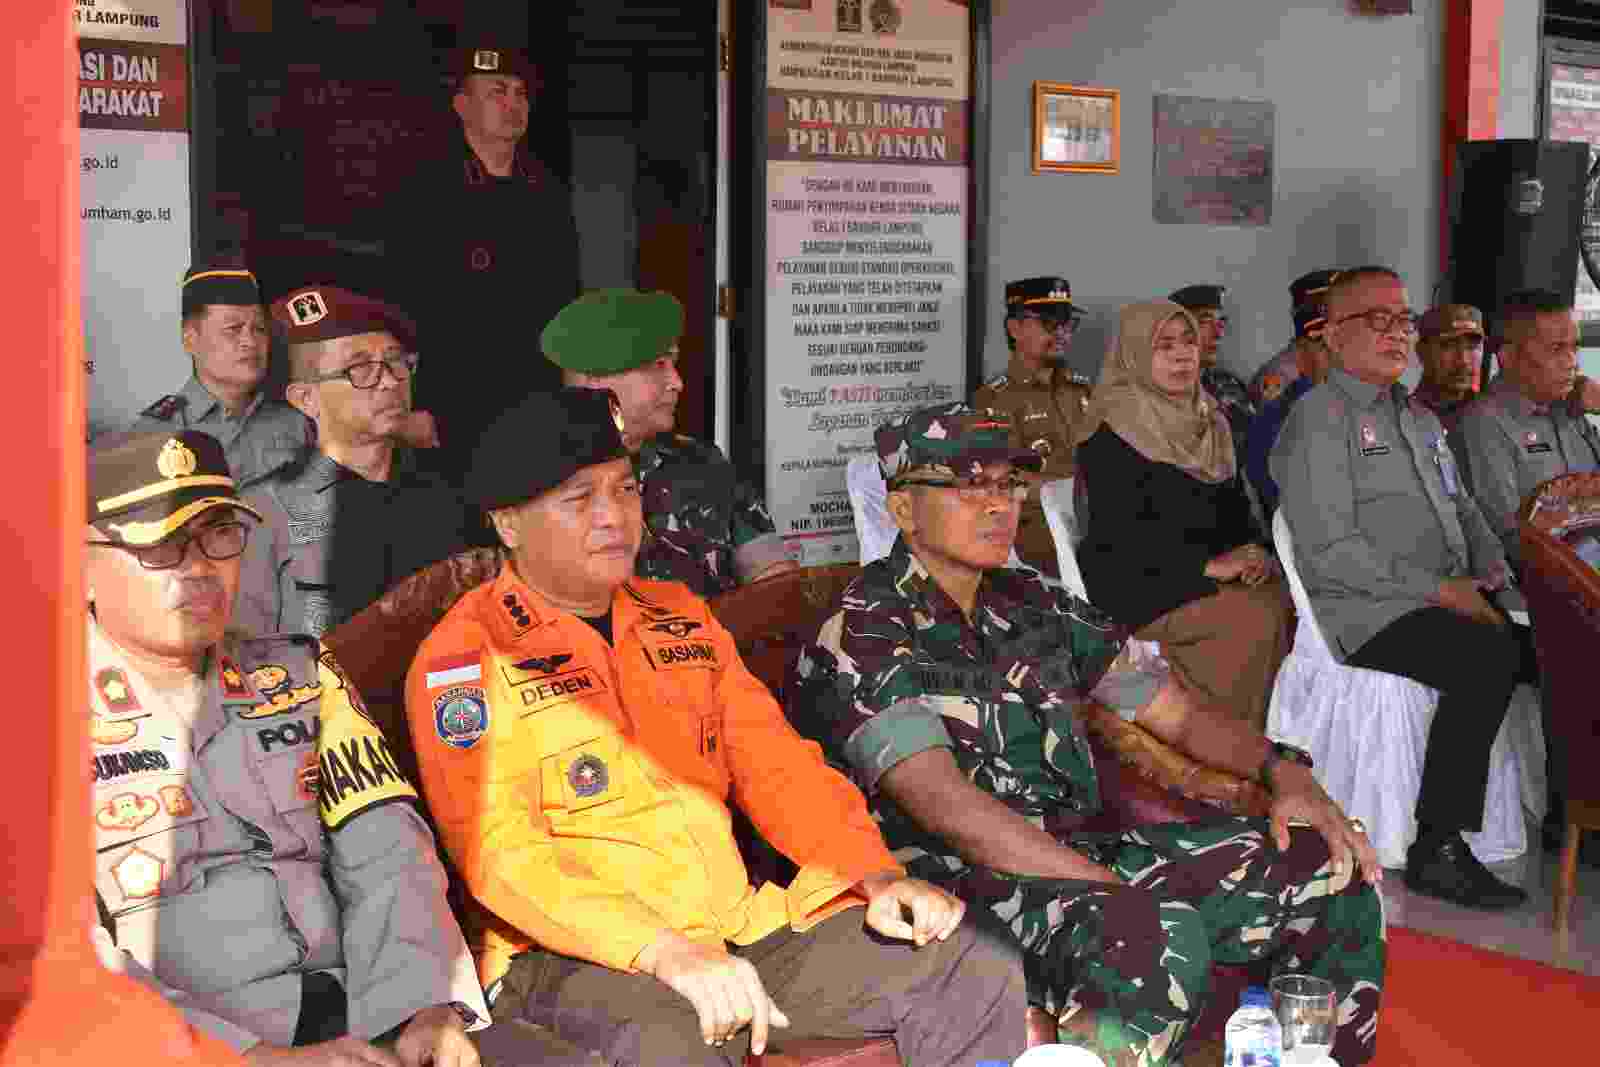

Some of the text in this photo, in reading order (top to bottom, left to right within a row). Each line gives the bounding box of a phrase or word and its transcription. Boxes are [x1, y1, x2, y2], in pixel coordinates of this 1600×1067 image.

[86, 11, 159, 28] LAMPUNG
[112, 54, 158, 82] DAN
[787, 97, 944, 129] MAKLUMAT
[788, 128, 946, 160] PELAYANAN
[520, 673, 592, 706] DEDEN
